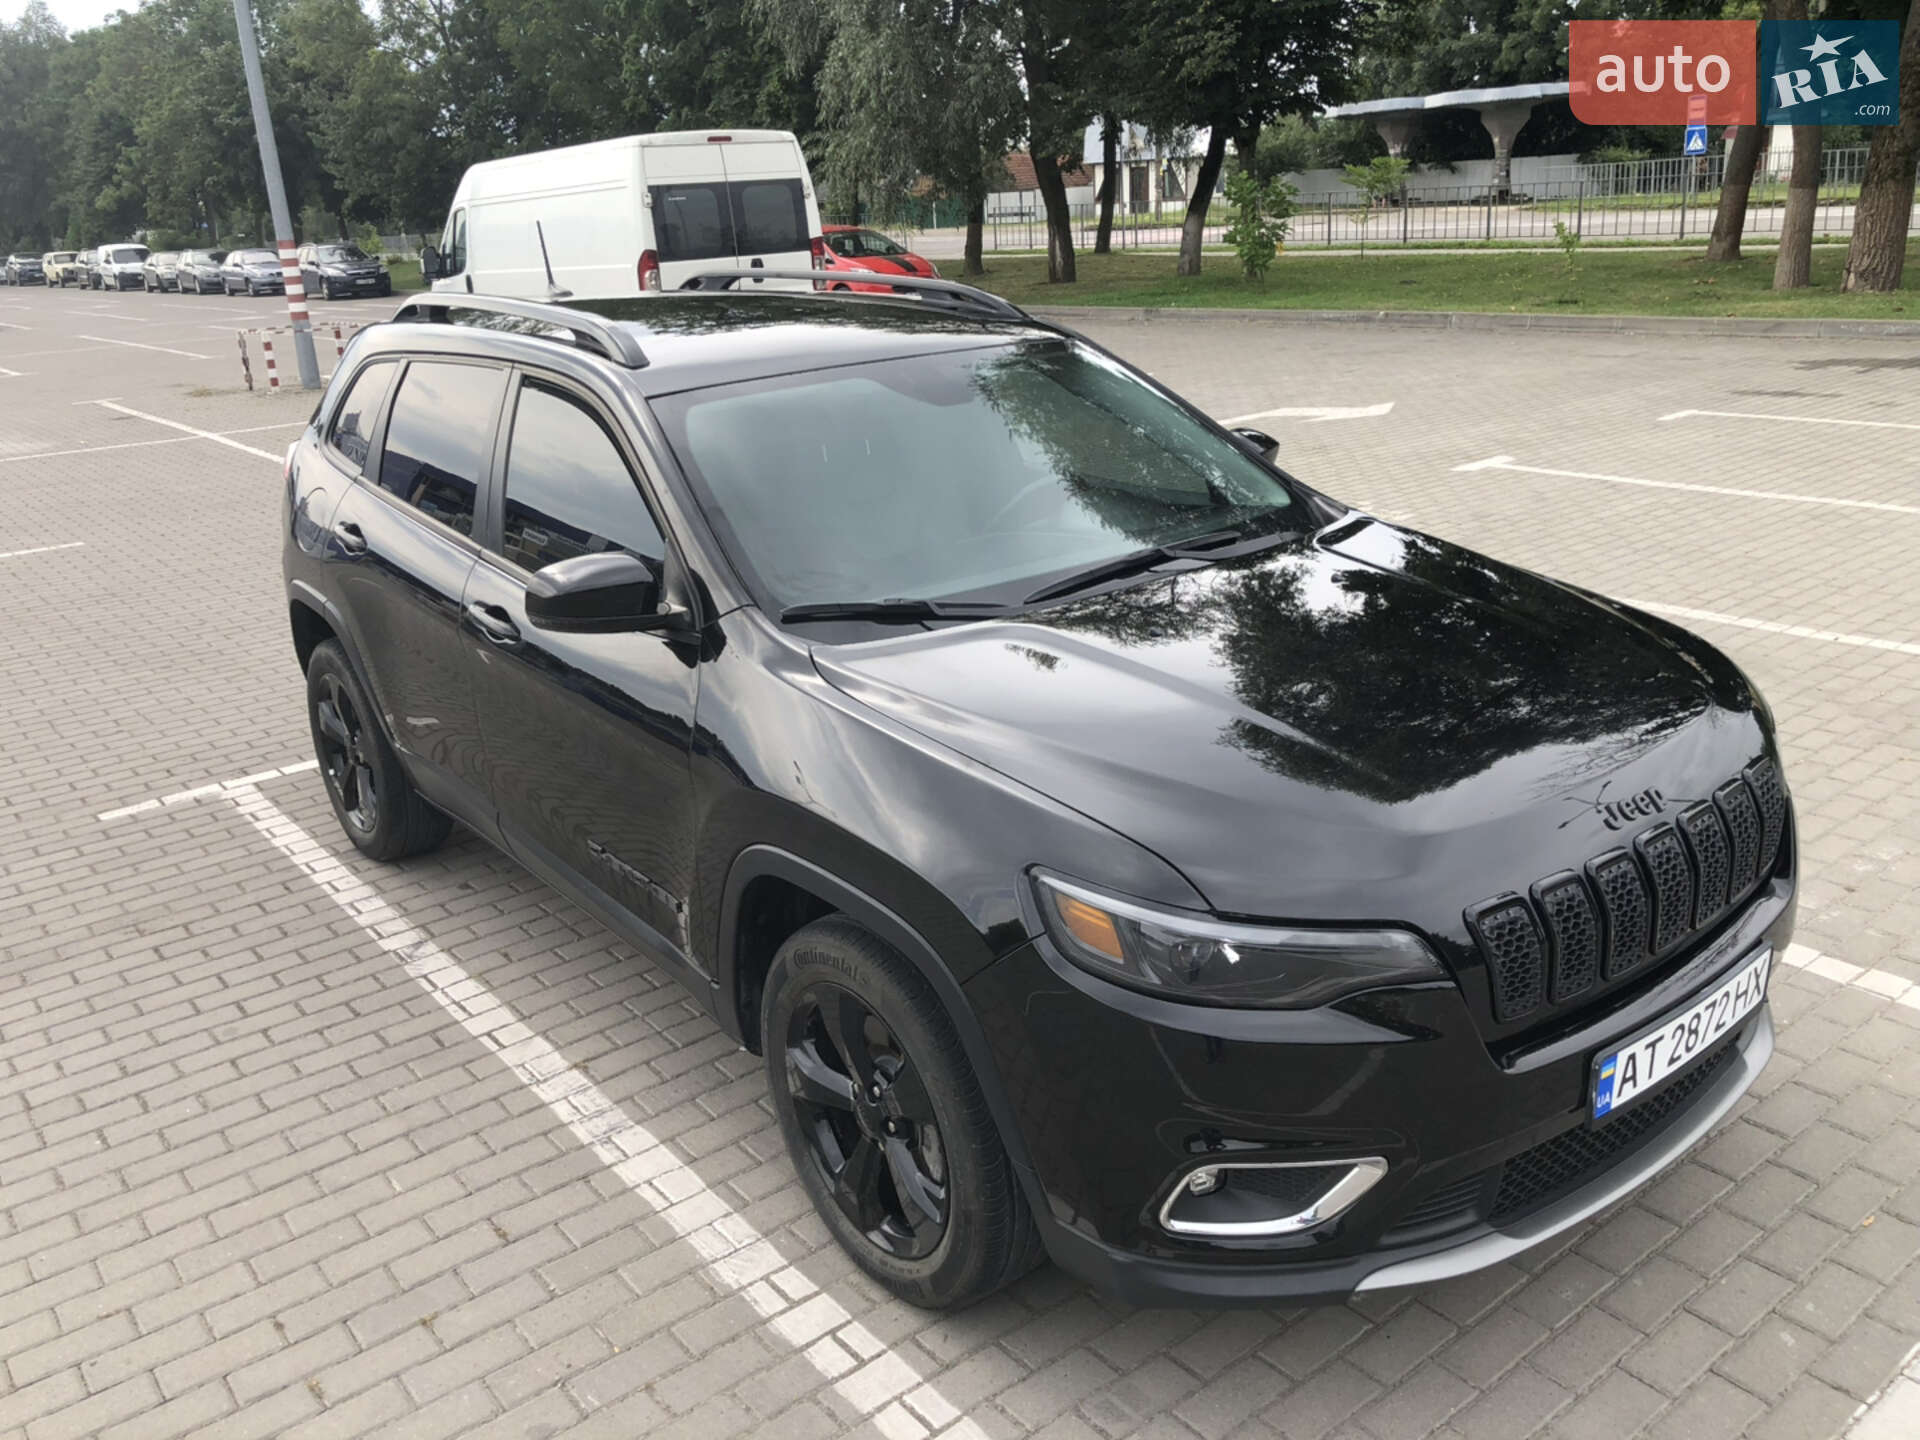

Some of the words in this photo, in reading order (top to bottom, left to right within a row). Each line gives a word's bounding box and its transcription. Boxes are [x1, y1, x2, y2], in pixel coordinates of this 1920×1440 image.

[1603, 786, 1665, 831] Jeep
[793, 947, 858, 982] Continental
[1617, 1034, 1665, 1098] AT
[1667, 990, 1730, 1068] 2872
[1731, 958, 1768, 1019] HX
[1596, 1091, 1610, 1108] UA
